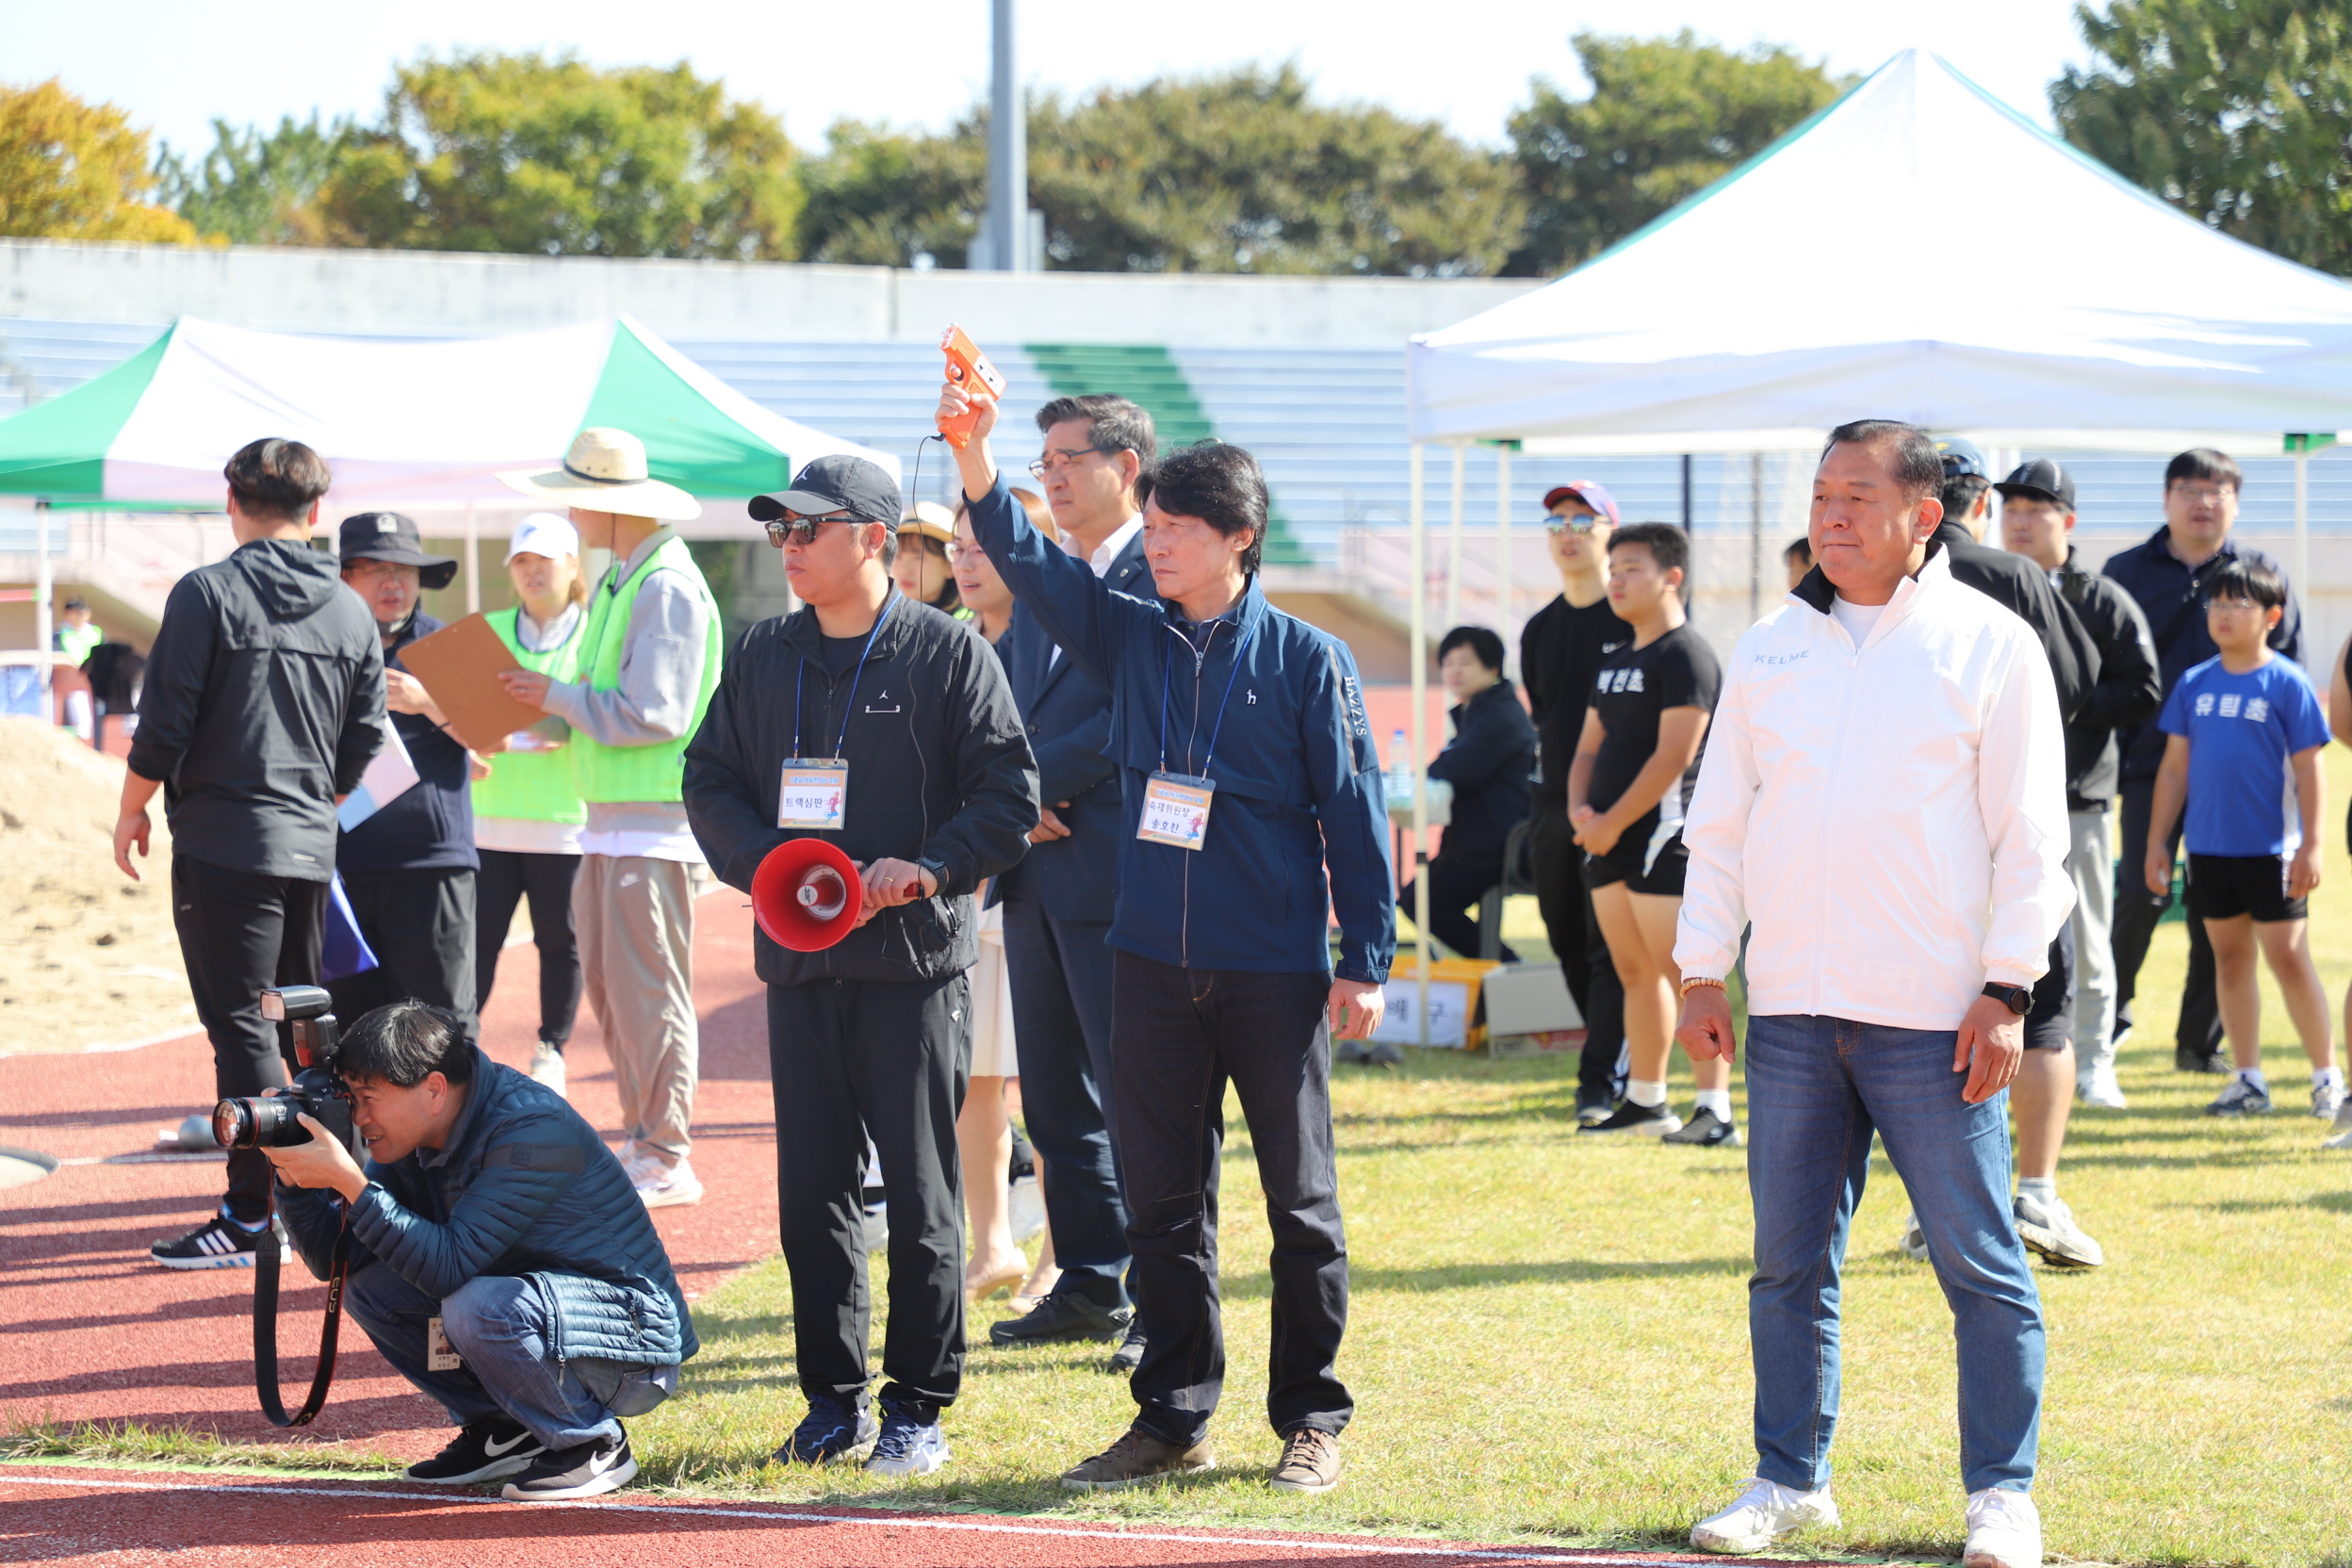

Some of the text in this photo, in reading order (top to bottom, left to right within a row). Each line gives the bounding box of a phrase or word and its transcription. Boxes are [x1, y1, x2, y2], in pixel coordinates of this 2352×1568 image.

[1755, 649, 1810, 665] KELME
[1344, 676, 1367, 736] HAZZYS
[2195, 692, 2269, 724] 유림초
[785, 797, 823, 808] 트랙심판
[1149, 801, 1190, 818] 축제위원장
[1151, 818, 1180, 834] 송호찬
[328, 1276, 341, 1314] EOS
